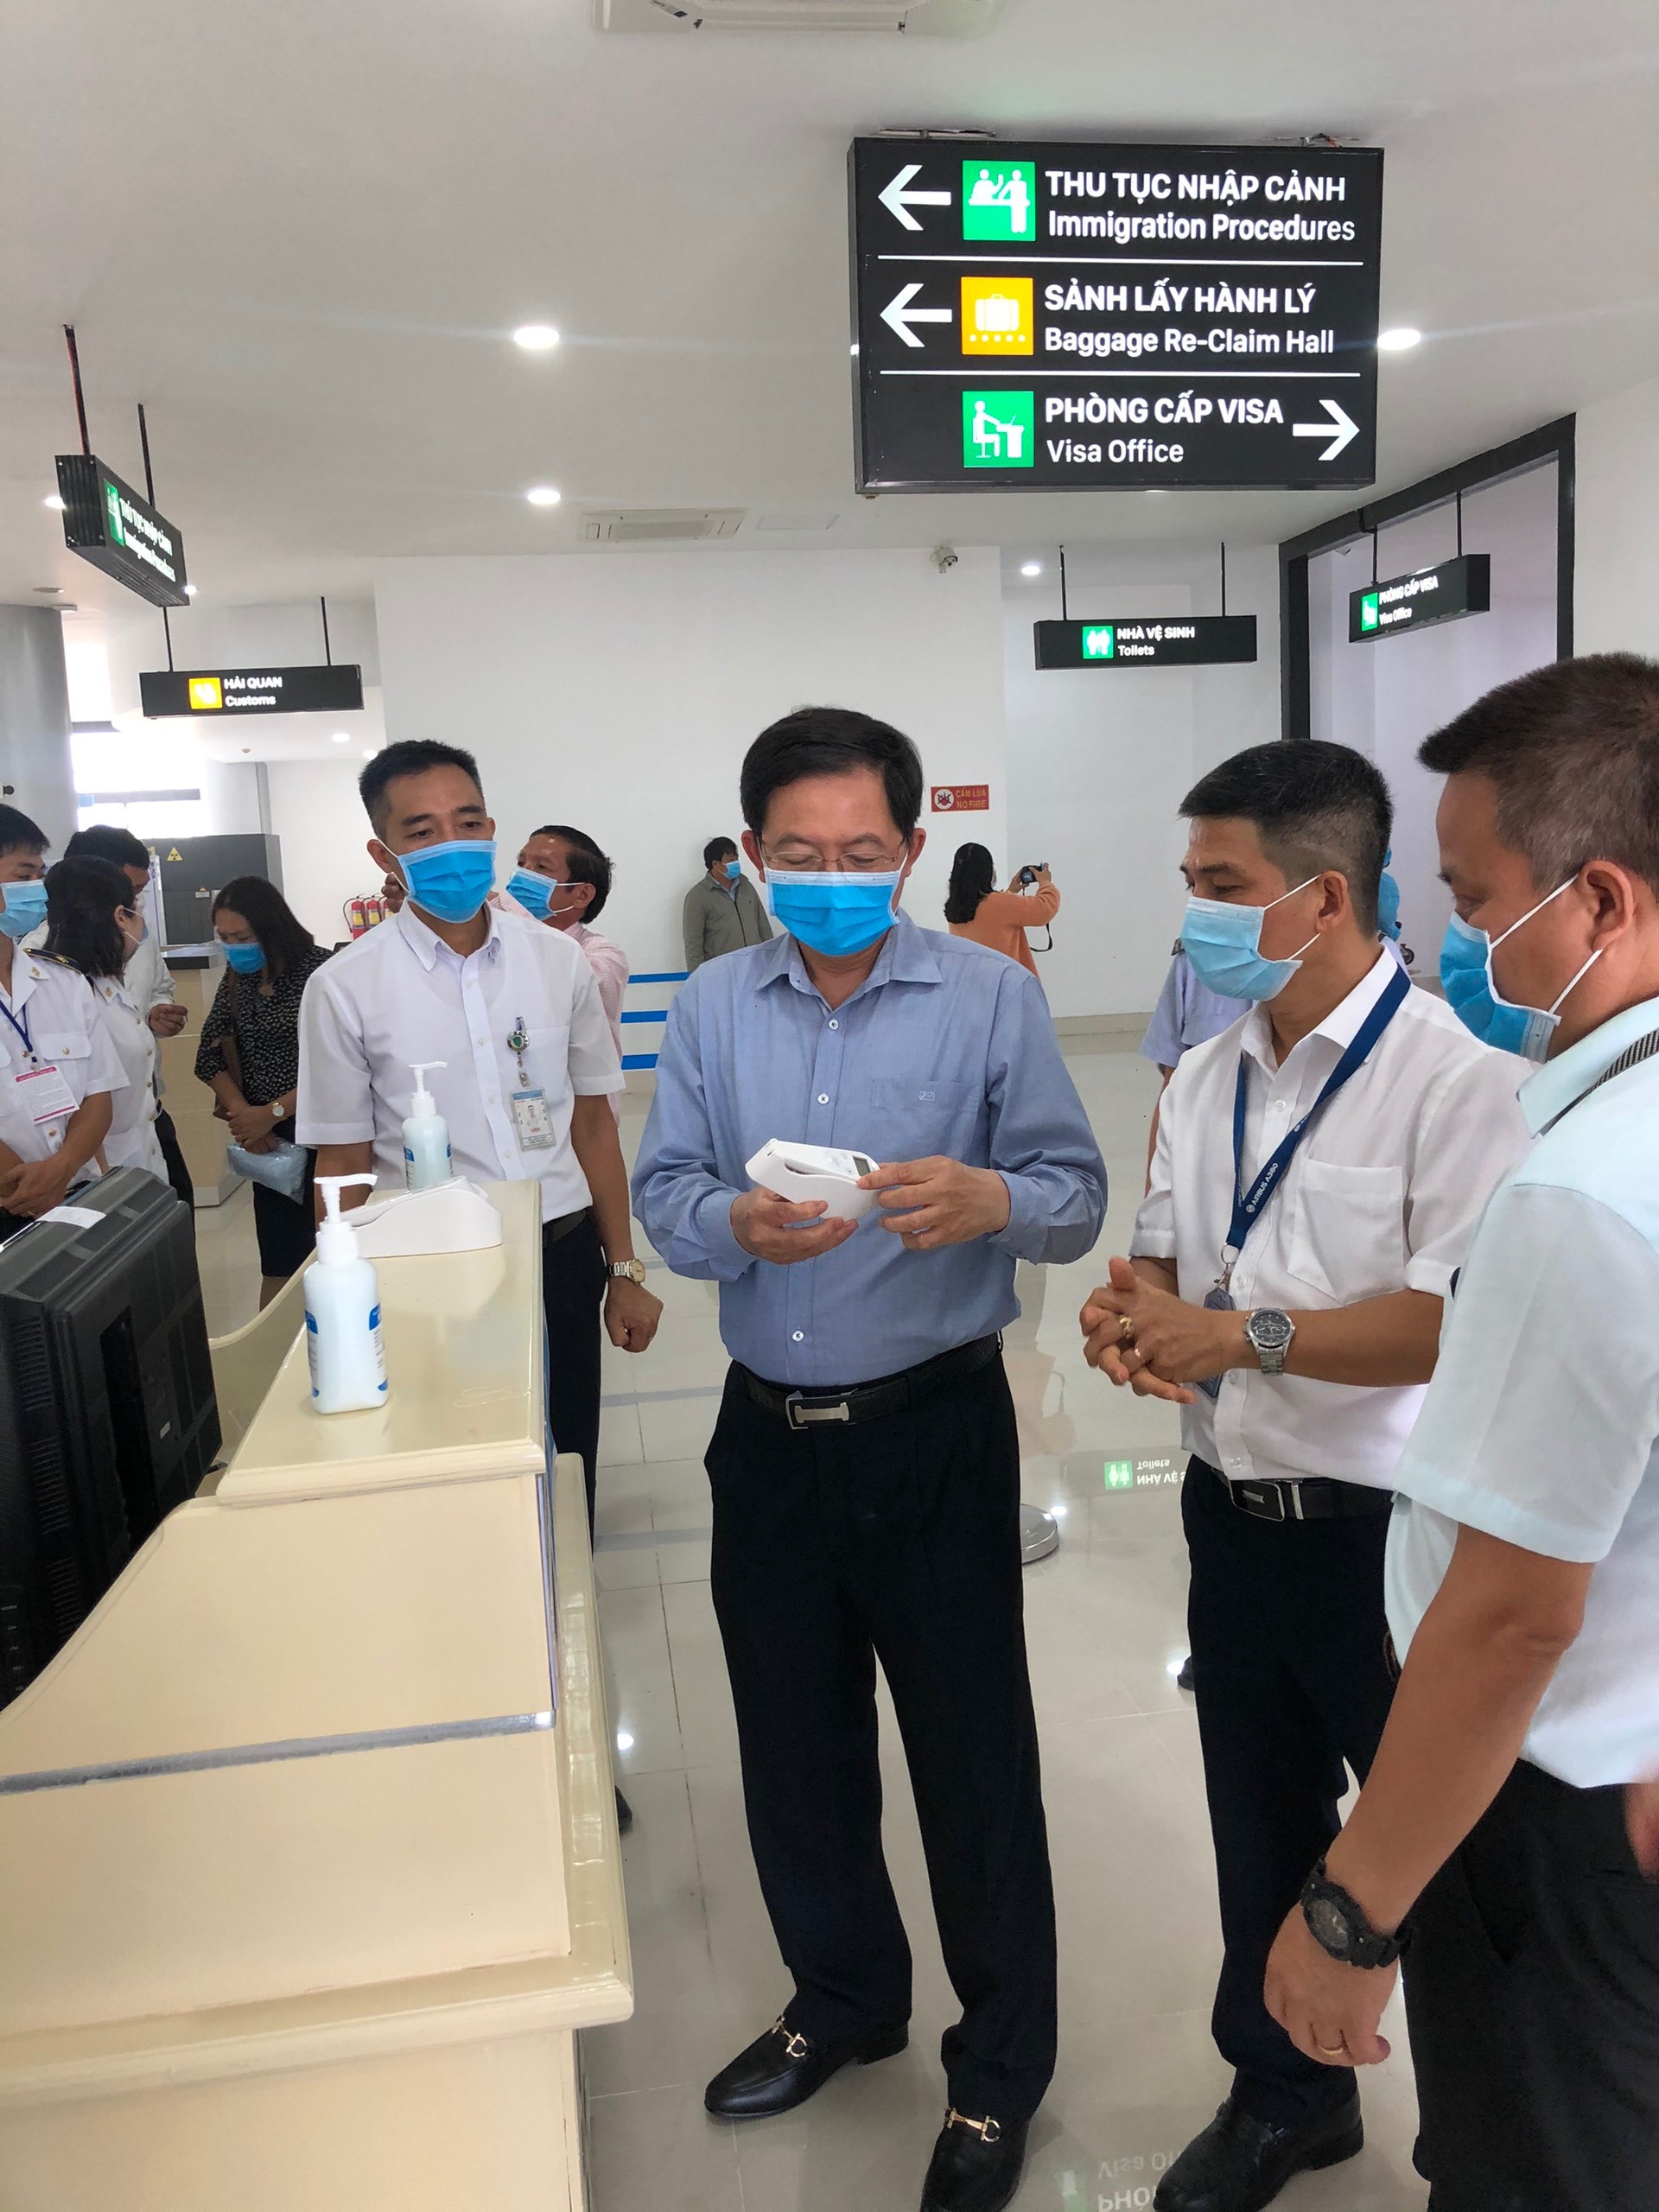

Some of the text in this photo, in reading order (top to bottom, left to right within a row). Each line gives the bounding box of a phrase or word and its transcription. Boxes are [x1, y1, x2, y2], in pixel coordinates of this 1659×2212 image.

[1045, 168, 1346, 207] THU TỤC NHẬP CẢNH
[1048, 210, 1356, 245] Immigration Procedures
[1044, 277, 1317, 314] SẢNH LẤY HÀNH LÝ
[1045, 327, 1335, 358] Baggage Re-Claim Hall
[1045, 389, 1285, 424] PHÒNG CẤP VISA
[1046, 438, 1185, 463] Visa Office
[1378, 584, 1404, 606] PHÒNG
[1420, 575, 1440, 594] VISA
[1378, 607, 1413, 626] Visa Office
[1116, 625, 1196, 641] NHÀ VỆ SINH
[1117, 645, 1155, 657] Toilets
[224, 676, 283, 690] HẢI QUAN
[225, 695, 276, 707] Customs
[957, 799, 987, 809] NO FIRE
[1251, 1162, 1279, 1205] AIRBUS A380
